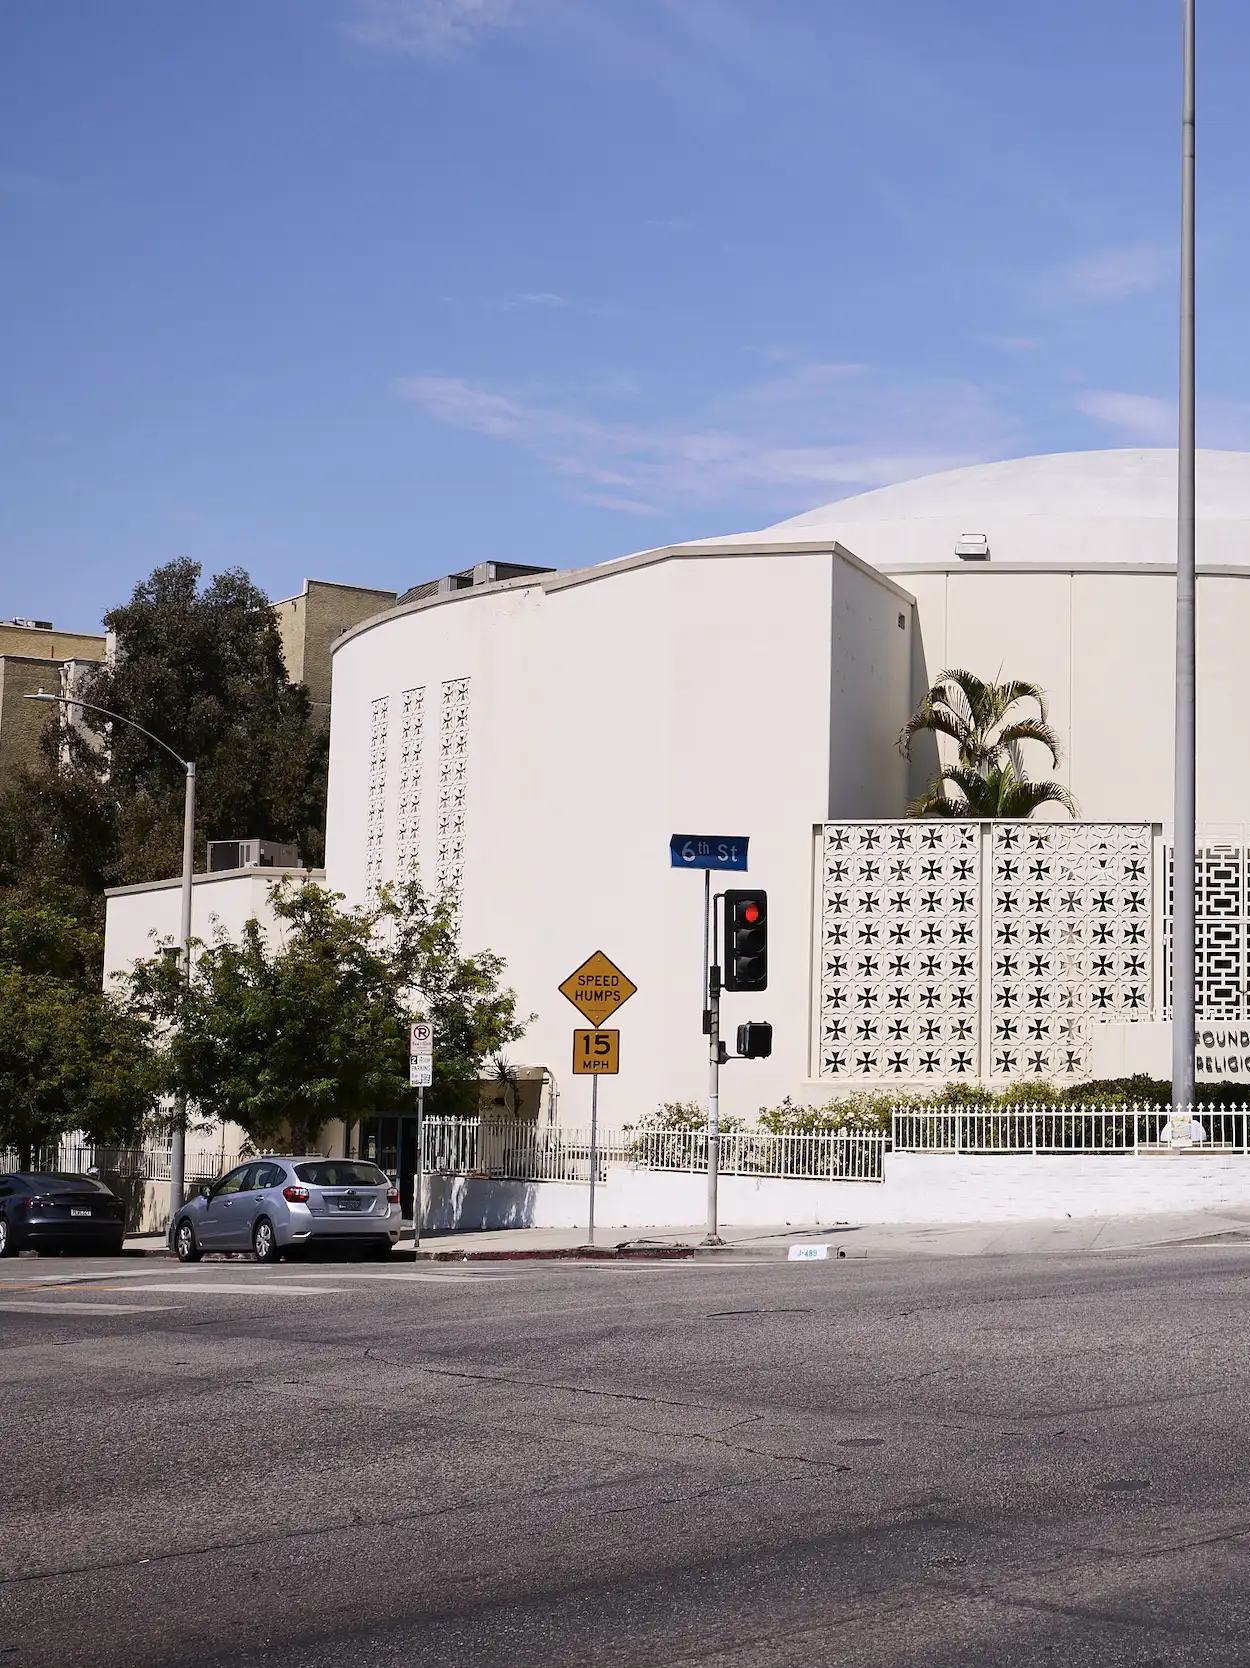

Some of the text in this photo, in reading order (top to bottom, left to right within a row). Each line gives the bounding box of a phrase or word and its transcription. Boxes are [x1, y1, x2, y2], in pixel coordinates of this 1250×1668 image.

[682, 840, 738, 862] 6th St
[577, 975, 619, 987] SPEED
[575, 990, 621, 1001] HUMPS
[583, 1034, 611, 1055] 15
[583, 1060, 609, 1069] MPH
